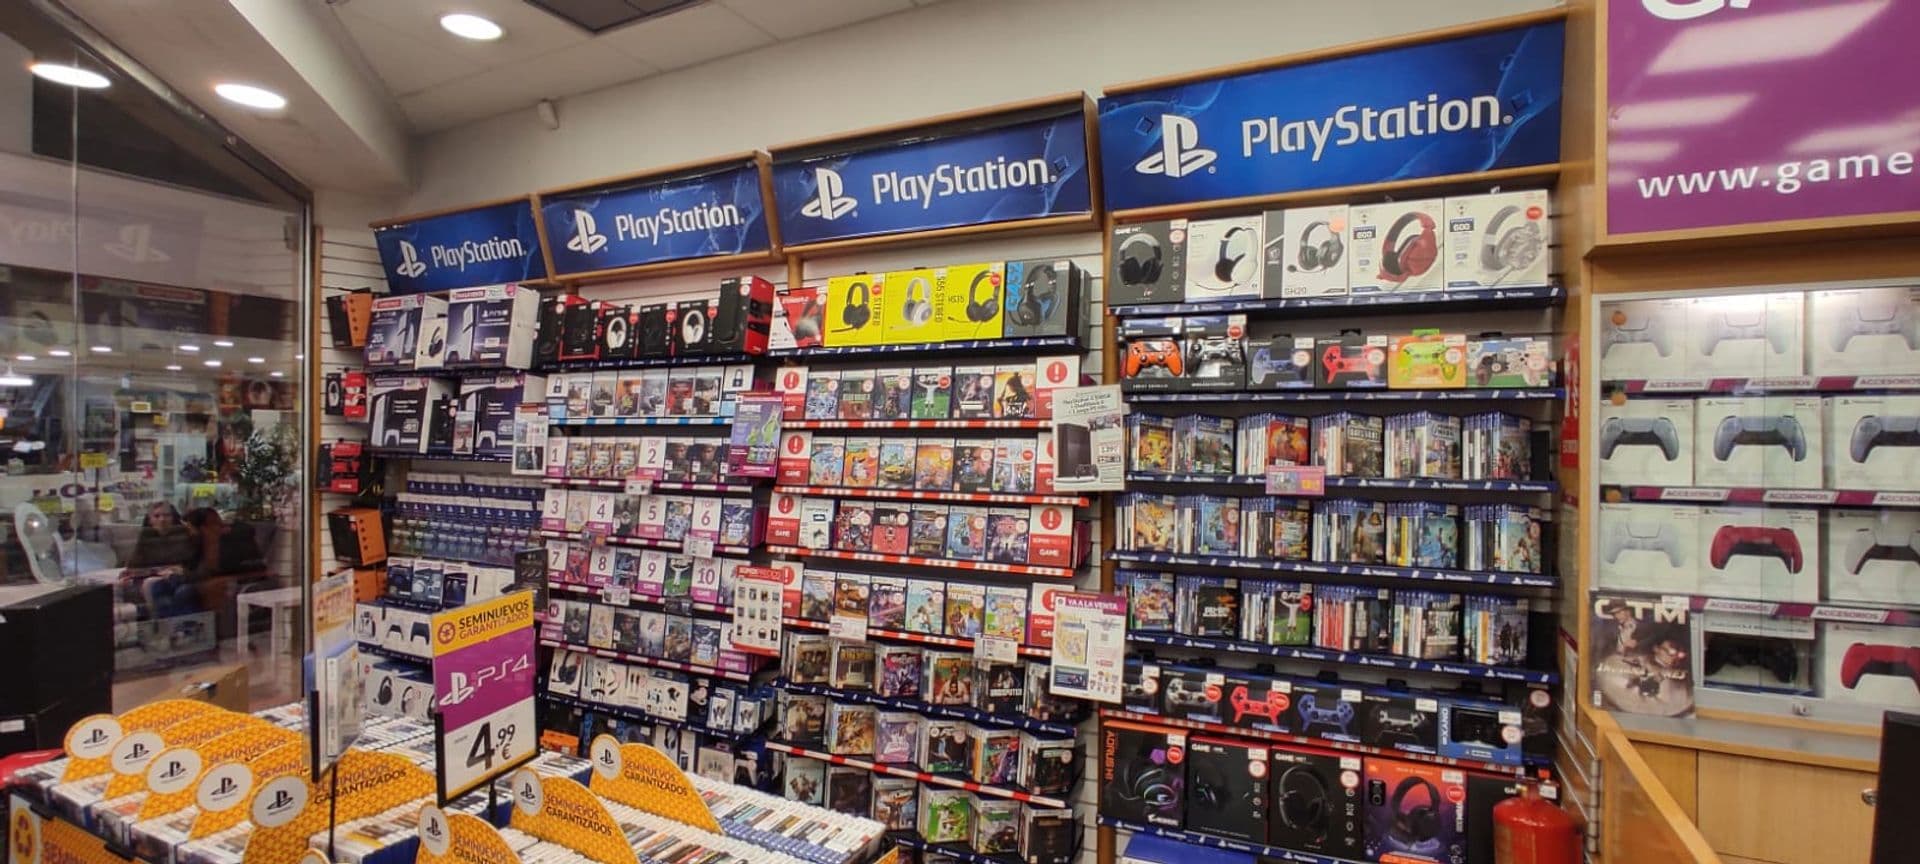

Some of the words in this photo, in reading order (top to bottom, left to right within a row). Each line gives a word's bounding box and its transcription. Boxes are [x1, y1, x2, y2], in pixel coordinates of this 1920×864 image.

[1242, 93, 1500, 161] PlayStation
[872, 156, 1049, 209] PlayStation
[1637, 150, 1914, 199] www.game
[616, 202, 741, 246] PlayStation
[431, 236, 523, 274] PlayStation
[1751, 377, 1813, 388] ACCESORIOS
[552, 449, 557, 462] 1
[648, 448, 656, 464] 2
[550, 500, 559, 515] 3
[597, 504, 605, 518] 4
[648, 506, 657, 521] 5
[701, 510, 711, 526] 6
[552, 551, 560, 566] 7
[1039, 549, 1060, 557] GAME
[598, 556, 606, 571] 8
[648, 562, 656, 577] 9
[699, 570, 715, 585] 10
[1094, 601, 1118, 609] VENTA
[459, 599, 529, 629] SEMINUEVOS
[1817, 609, 1880, 621] ACCESORIOS
[459, 612, 529, 640] GARANTIZADOS
[478, 653, 532, 688] PS4
[209, 737, 287, 763] SEMINUEVOS
[501, 743, 512, 760] €
[1192, 743, 1210, 752] GAME
[1275, 753, 1294, 761] GAME
[624, 760, 676, 783] SEMINUEVOS
[314, 770, 407, 805] GARANTIZADOS
[624, 771, 688, 797] GARANTIZADOS
[546, 794, 599, 820] SEMINUEVOS
[546, 806, 612, 837] GARANTIZADOS
